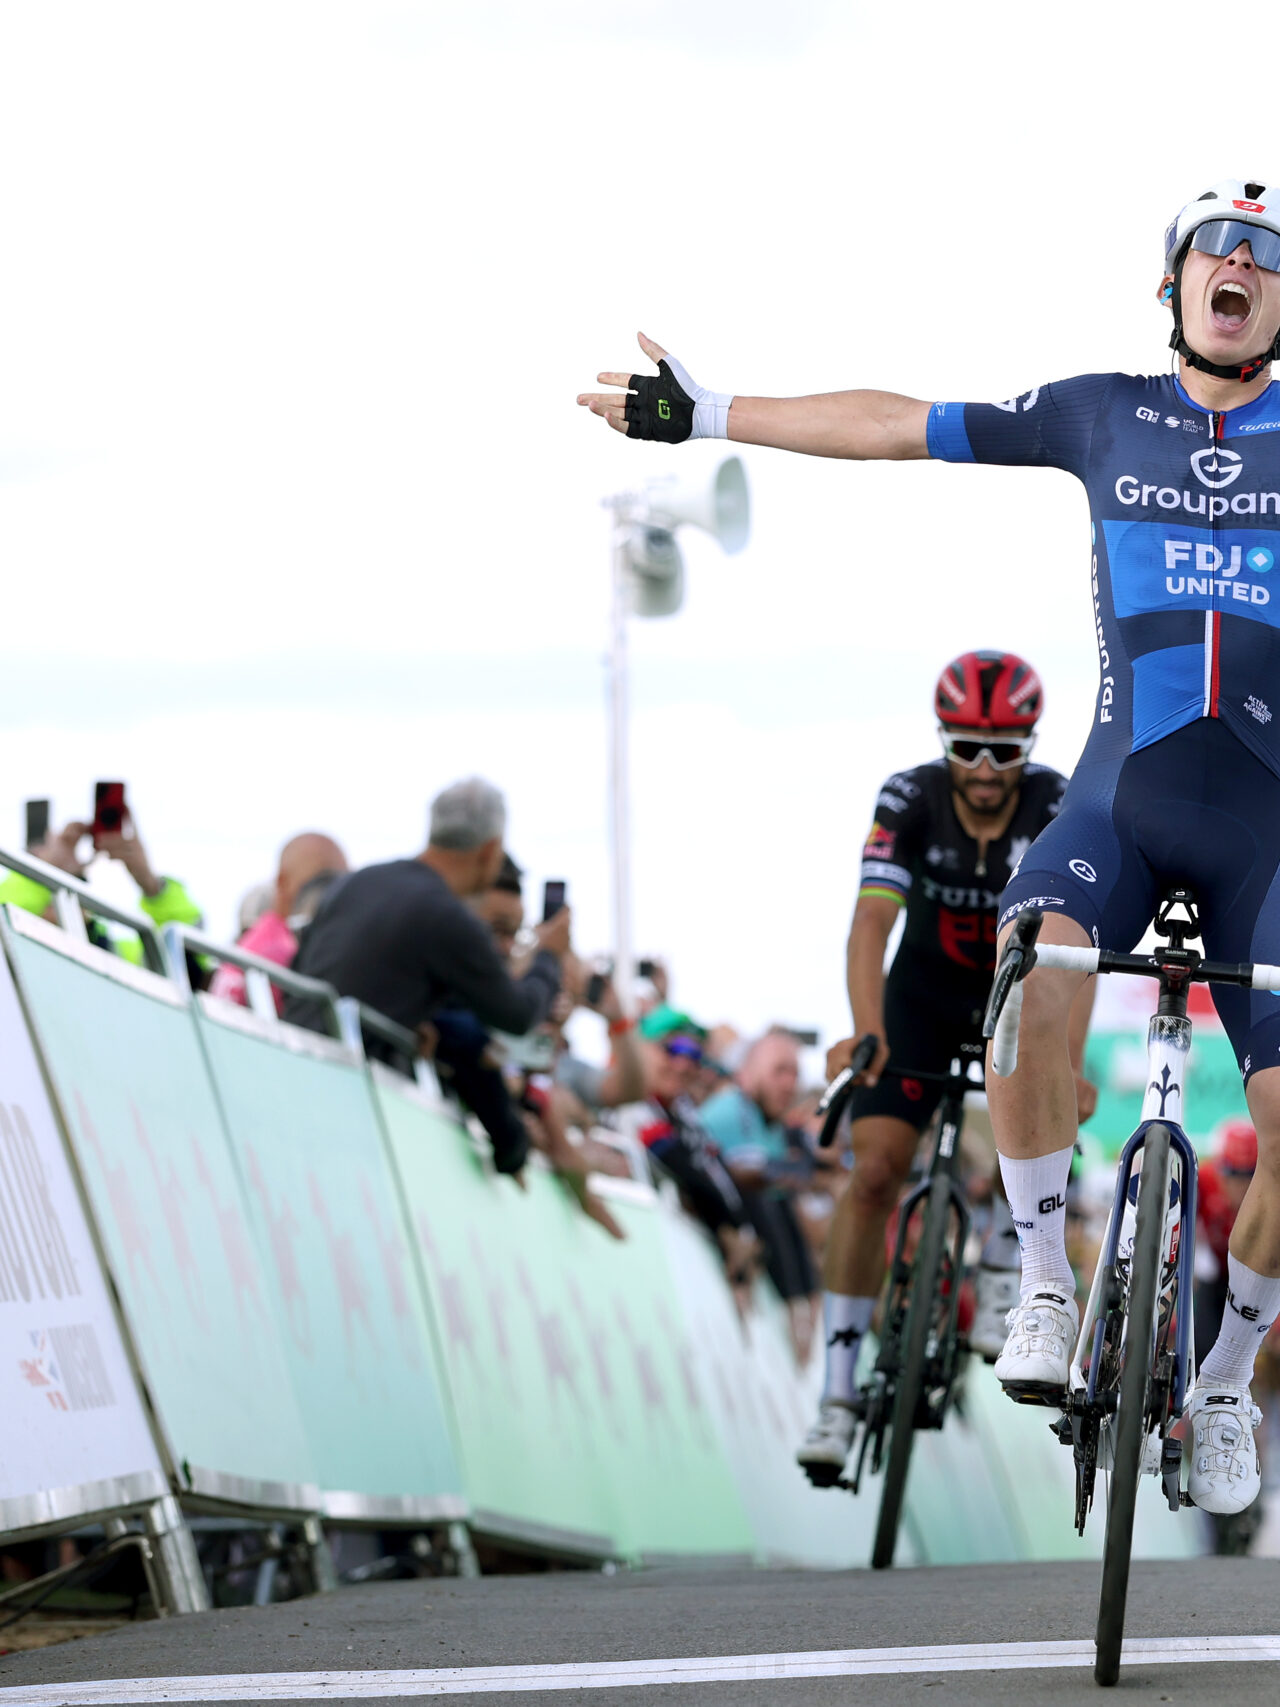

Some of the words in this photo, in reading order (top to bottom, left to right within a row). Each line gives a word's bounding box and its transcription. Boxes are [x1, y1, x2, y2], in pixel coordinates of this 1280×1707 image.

[1165, 540, 1242, 577] FDJ
[1166, 577, 1270, 605] UNITED
[1100, 675, 1115, 724] FDJ
